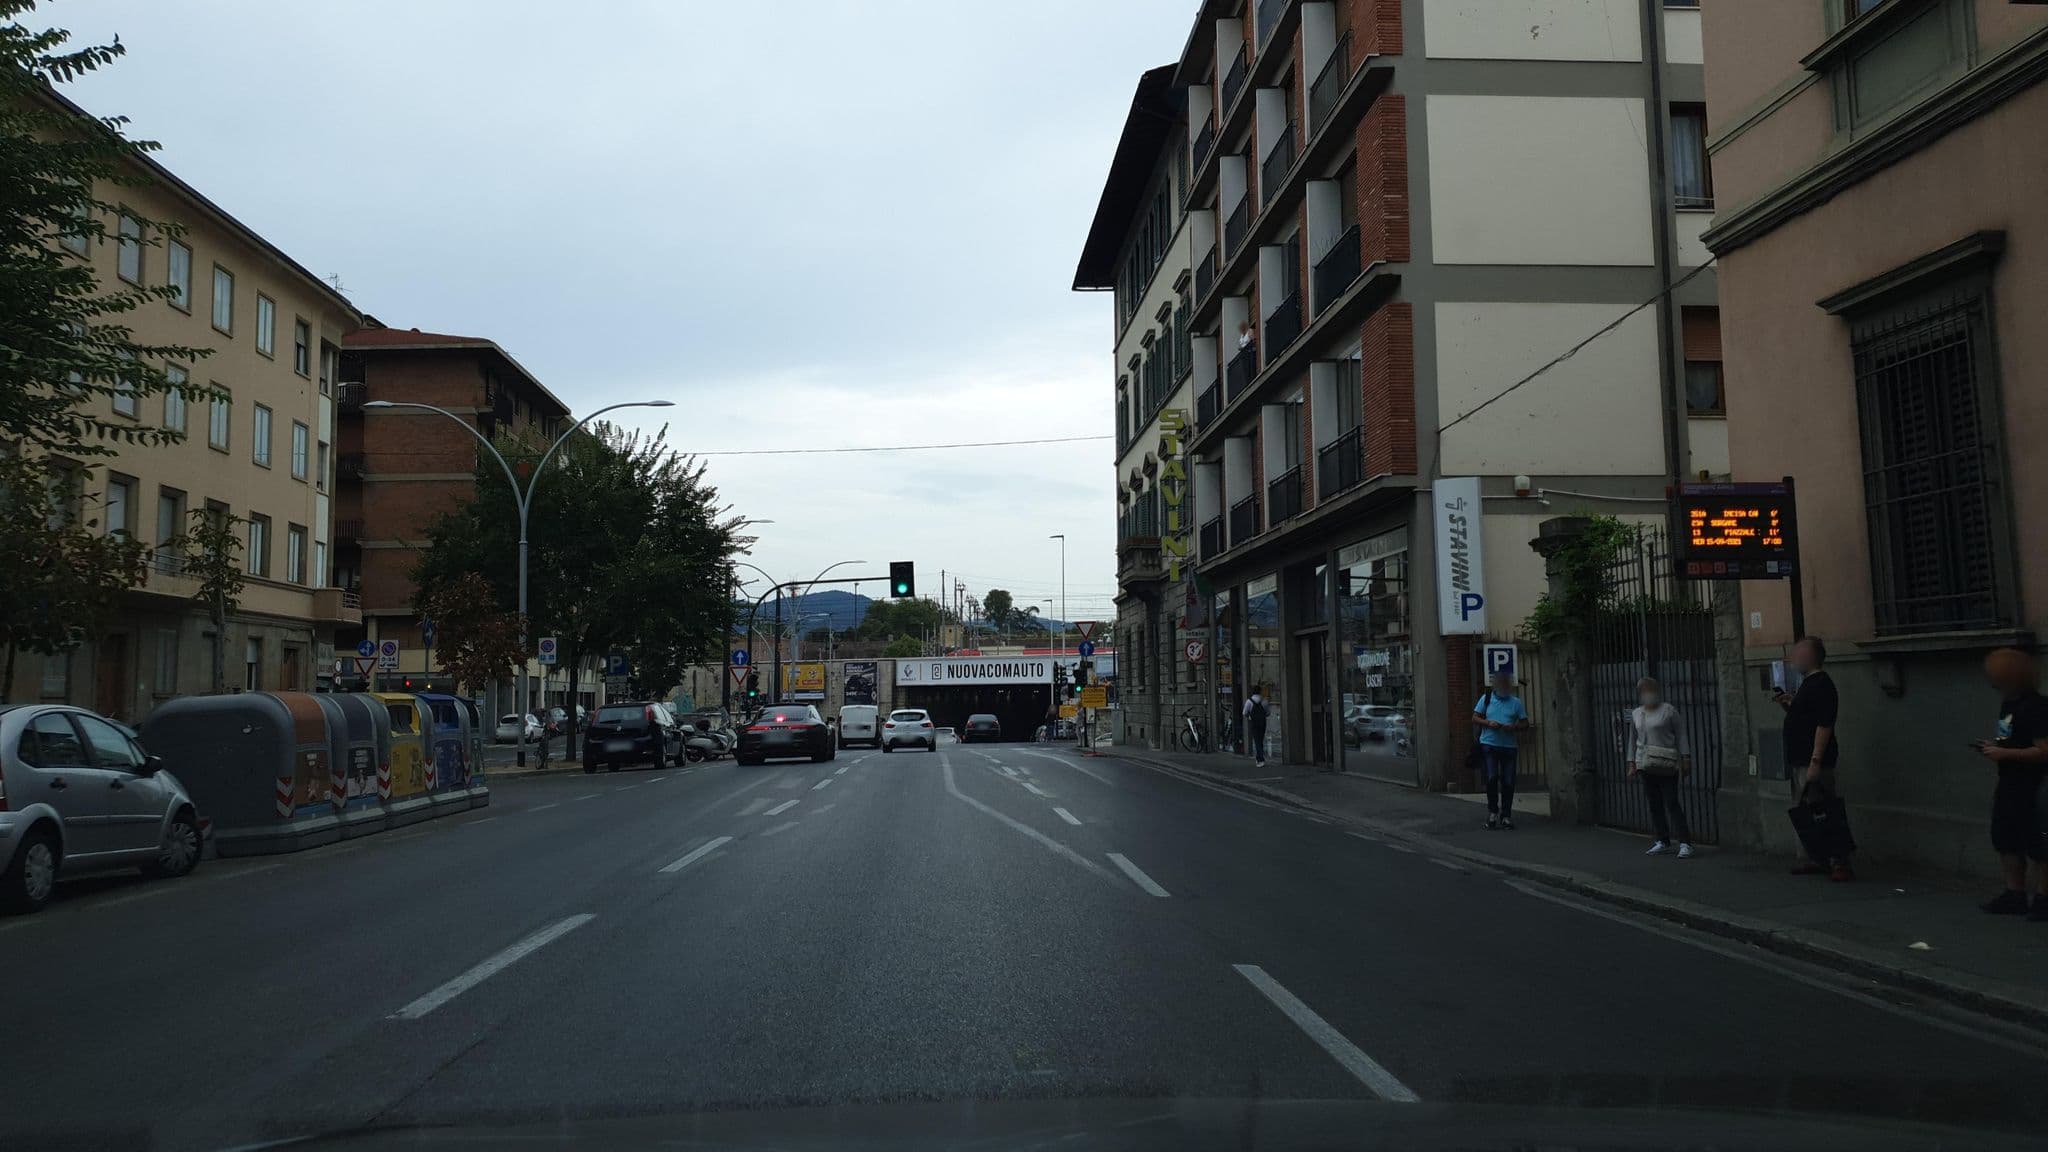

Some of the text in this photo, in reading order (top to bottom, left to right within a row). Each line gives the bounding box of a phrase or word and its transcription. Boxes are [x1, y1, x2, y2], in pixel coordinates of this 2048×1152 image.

[1159, 408, 1188, 582] STAVINI
[1724, 528, 1755, 536] PIAZZALE
[1449, 514, 1471, 592] STAVINI
[1462, 593, 1484, 622] P
[609, 655, 624, 674] P
[947, 662, 1044, 679] NUOVACOMAUTO
[1494, 650, 1510, 672] P
[1365, 673, 1383, 688] CASCHI
